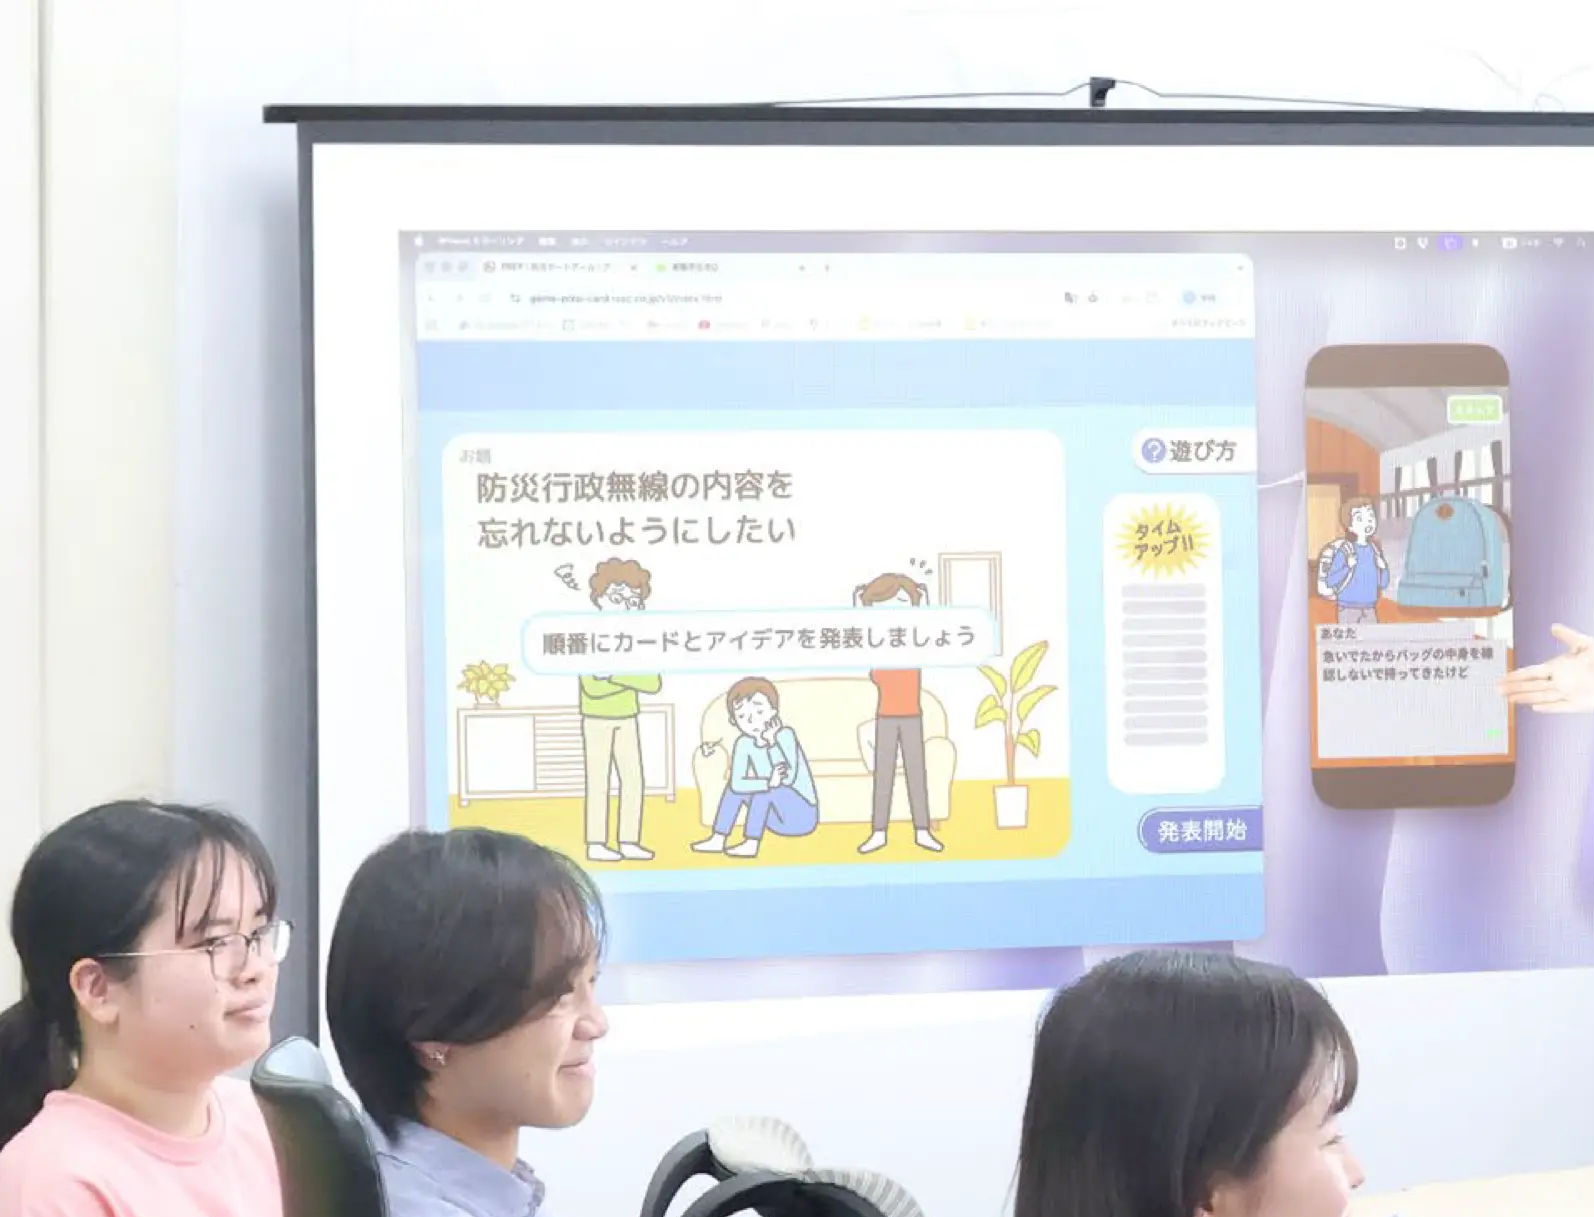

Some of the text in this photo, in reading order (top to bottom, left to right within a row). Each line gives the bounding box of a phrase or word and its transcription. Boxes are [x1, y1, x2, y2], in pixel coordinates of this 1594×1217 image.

[1169, 439, 1237, 462] 遊び方
[477, 470, 793, 503] 防災行政無線の内容を
[478, 514, 796, 549] 忘れないようにしたい
[1135, 518, 1182, 541] タイム
[542, 625, 975, 656] 順番にカードとアイデアを発表しましょう
[1320, 626, 1357, 640] あなた
[1158, 818, 1248, 842] 発表開始
